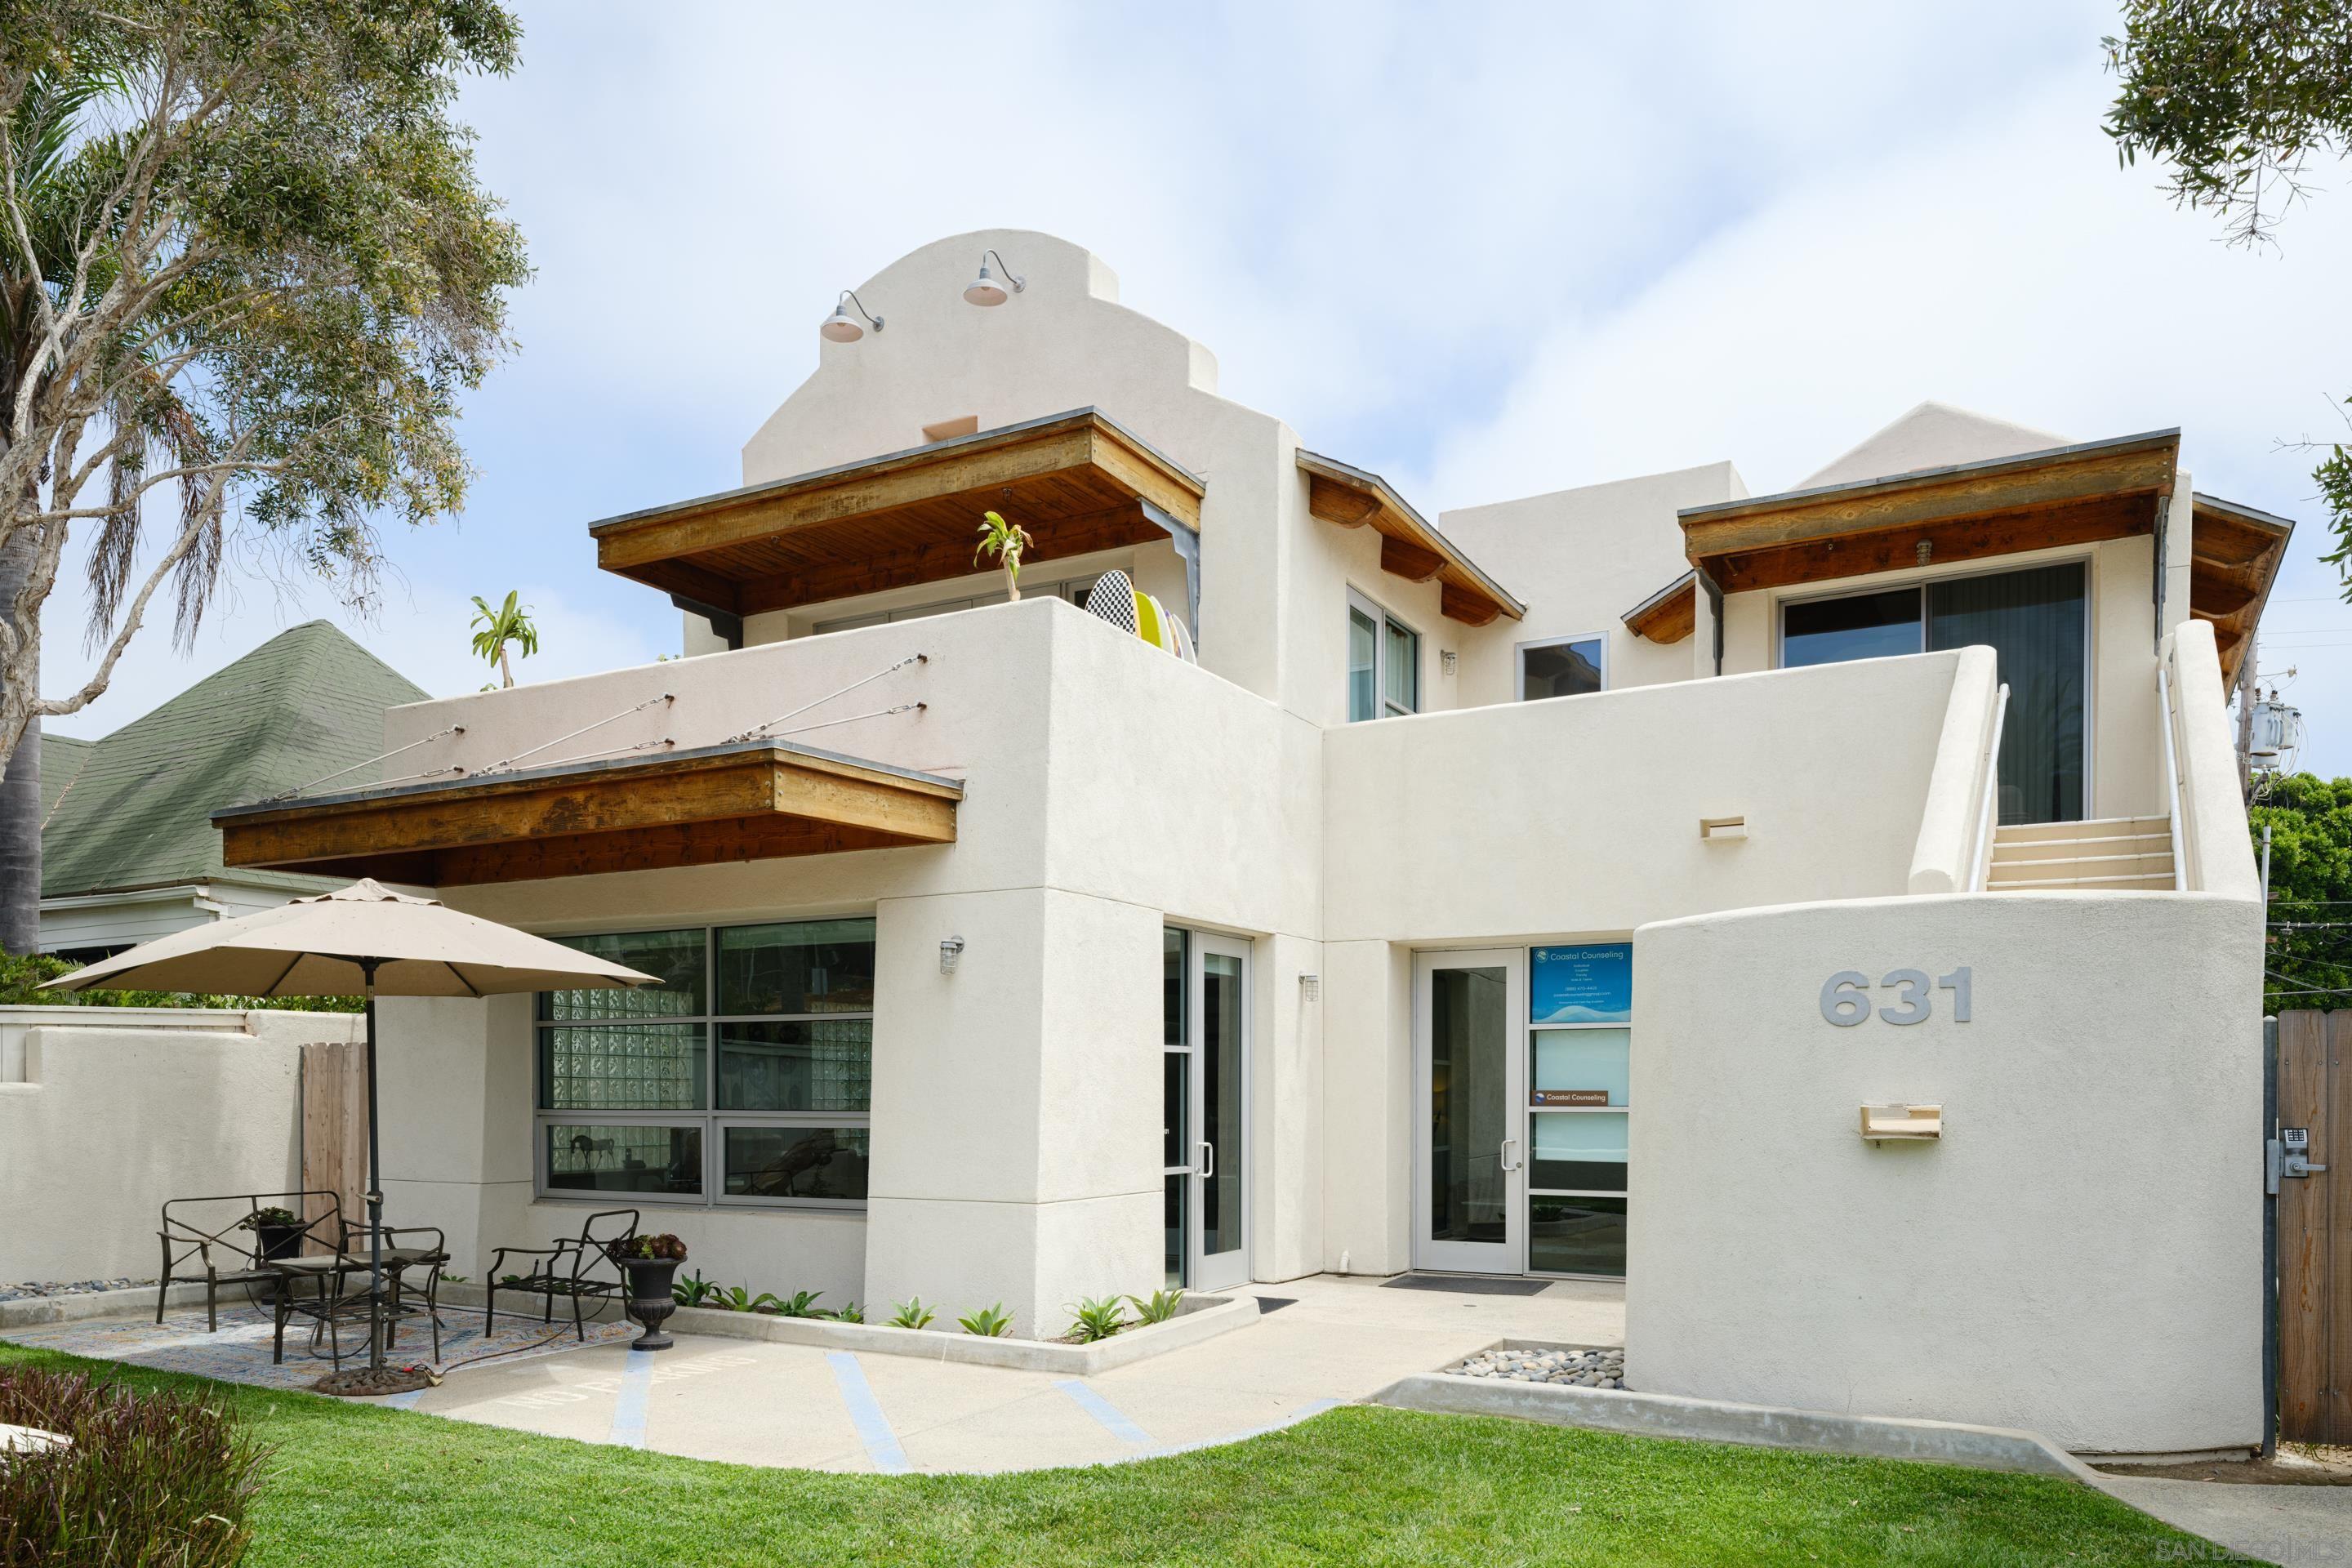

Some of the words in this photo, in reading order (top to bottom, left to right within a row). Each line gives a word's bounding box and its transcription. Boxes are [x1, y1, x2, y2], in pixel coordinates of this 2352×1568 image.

[1550, 952, 1579, 961] Coastal
[1581, 951, 1624, 960] Counseling
[1820, 966, 1971, 1027] 631
